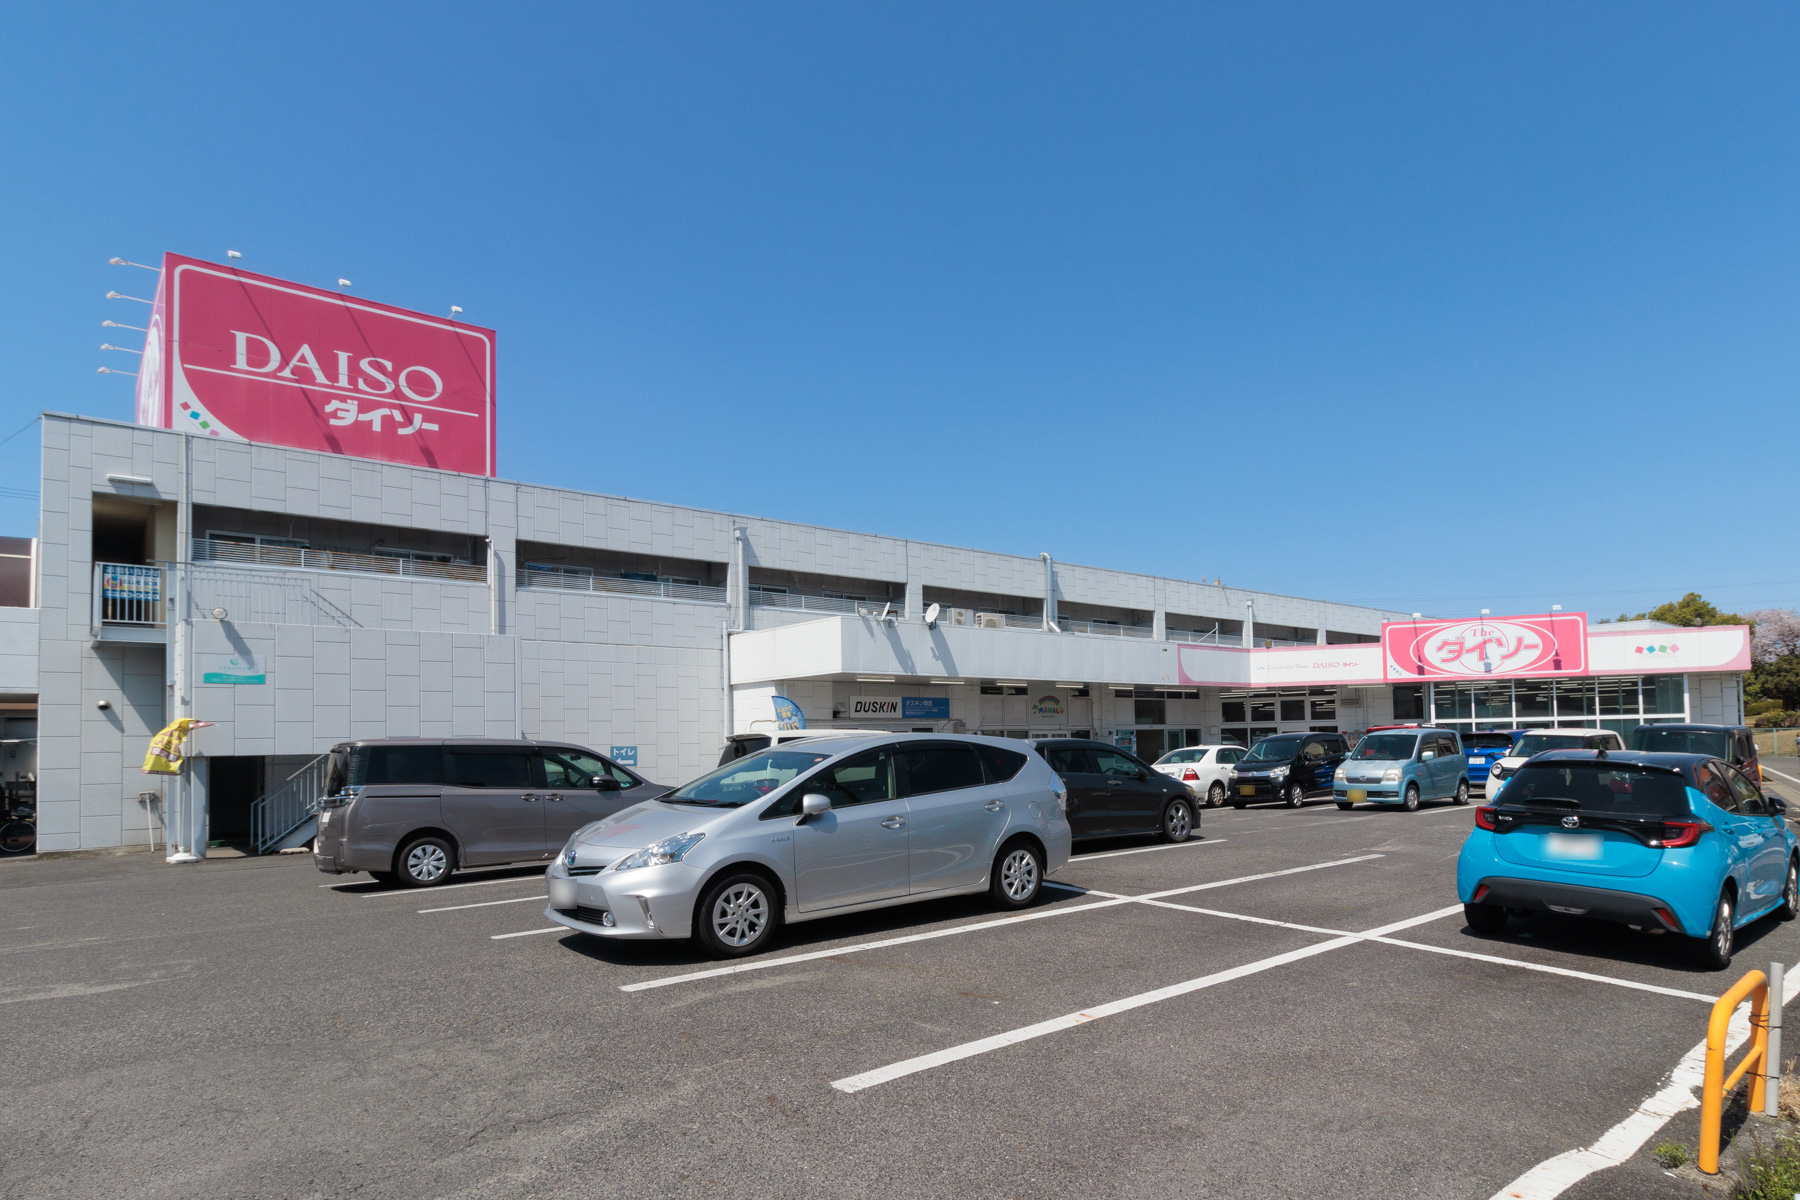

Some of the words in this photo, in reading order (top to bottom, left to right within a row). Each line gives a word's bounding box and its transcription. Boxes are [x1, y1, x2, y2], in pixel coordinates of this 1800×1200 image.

[230, 330, 443, 402] DAISO
[324, 399, 439, 435] ダイソー
[1470, 627, 1495, 638] The
[1435, 635, 1540, 665] ダイソー
[1312, 661, 1340, 669] DAISO
[613, 748, 635, 756] トイレ
